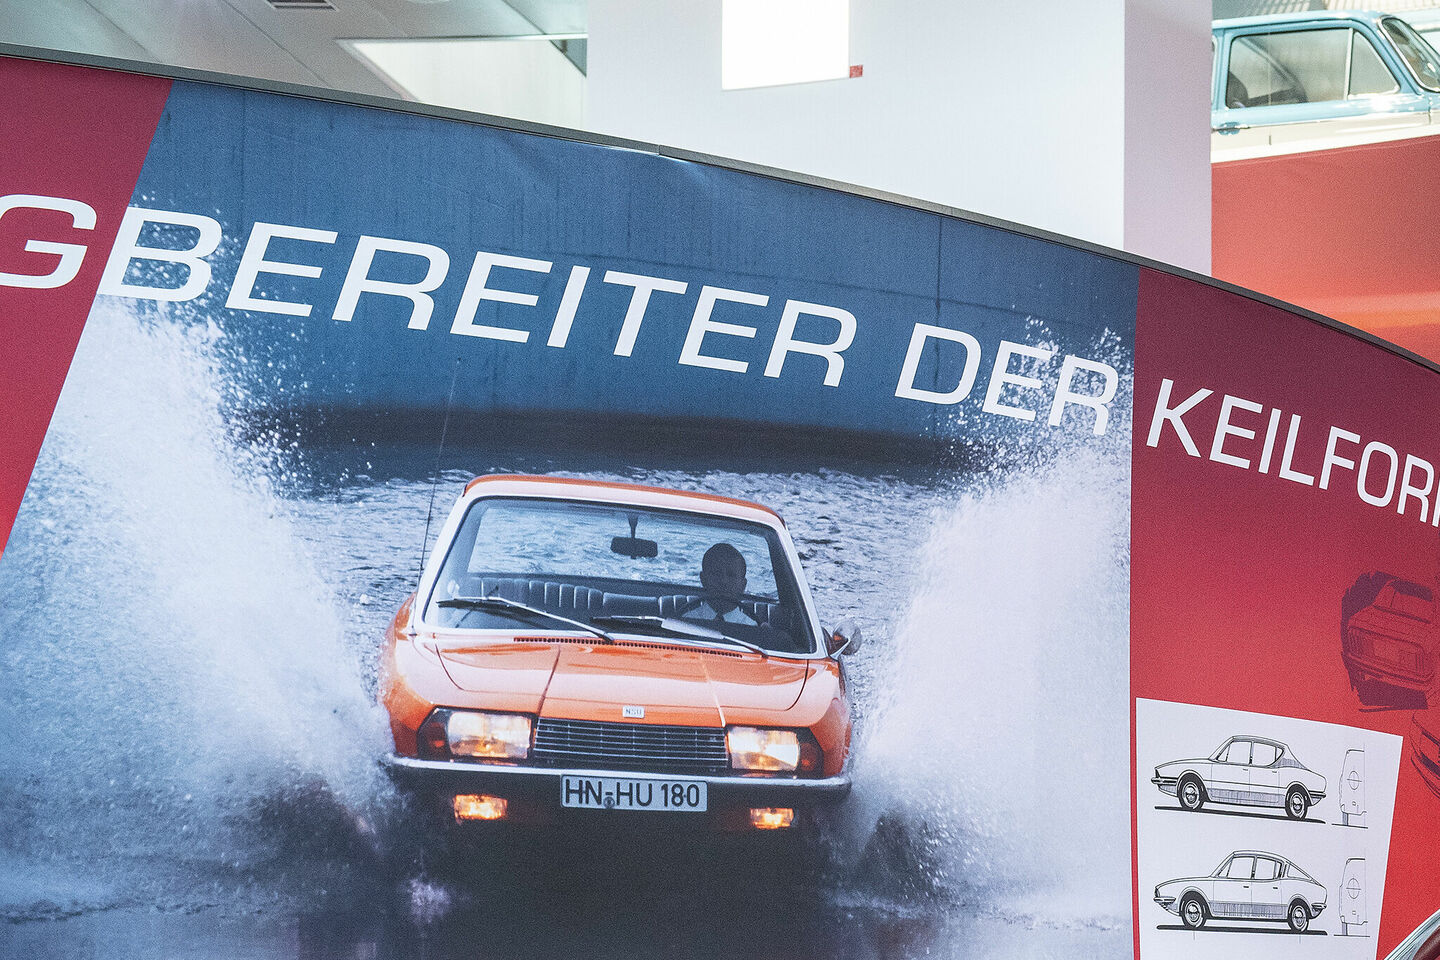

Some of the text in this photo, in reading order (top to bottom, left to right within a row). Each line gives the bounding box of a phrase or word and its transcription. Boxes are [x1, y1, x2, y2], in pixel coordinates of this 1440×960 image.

[0, 194, 857, 388] GBEREITER
[894, 322, 1119, 436] DER
[565, 778, 700, 808] HN-HU 180
